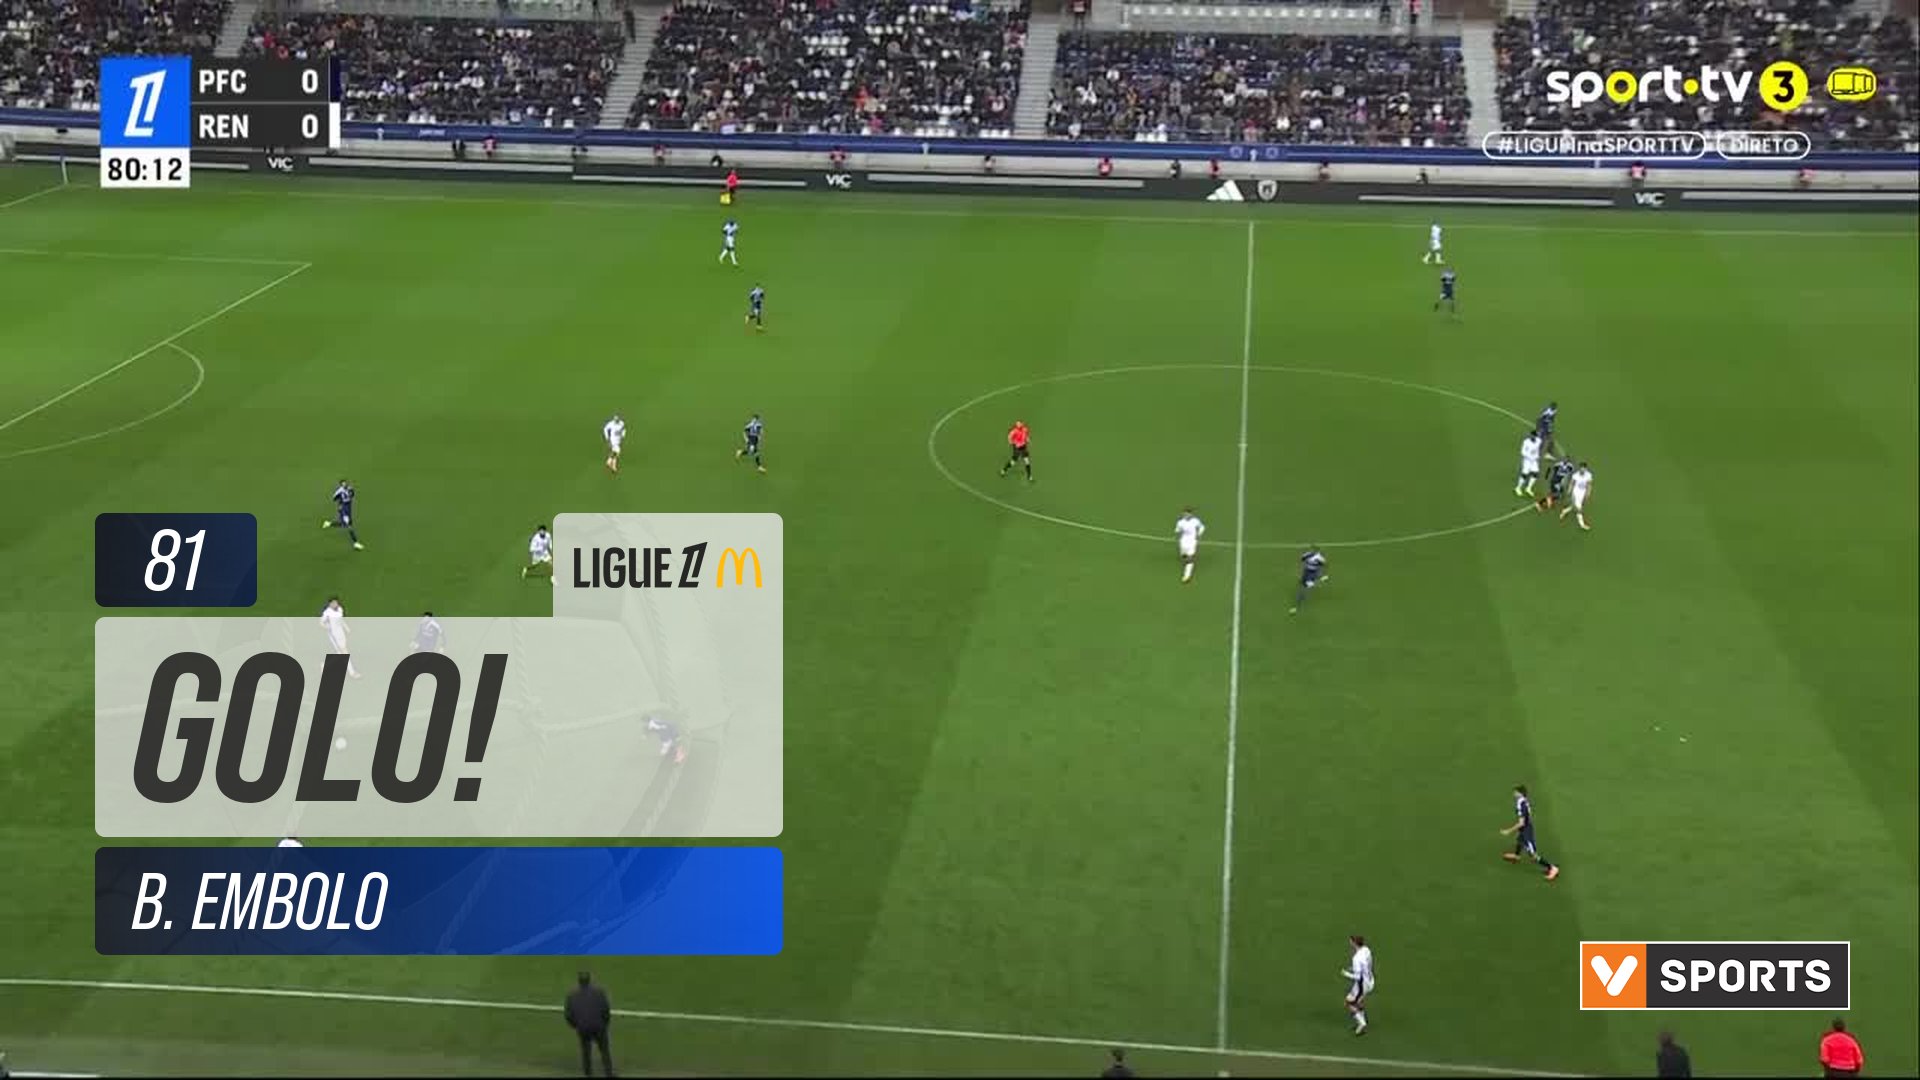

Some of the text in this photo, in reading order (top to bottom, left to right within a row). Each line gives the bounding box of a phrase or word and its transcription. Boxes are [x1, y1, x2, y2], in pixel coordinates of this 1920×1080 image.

[267, 157, 294, 172] VIC
[825, 173, 852, 189] VIC
[1634, 191, 1665, 207] VIC
